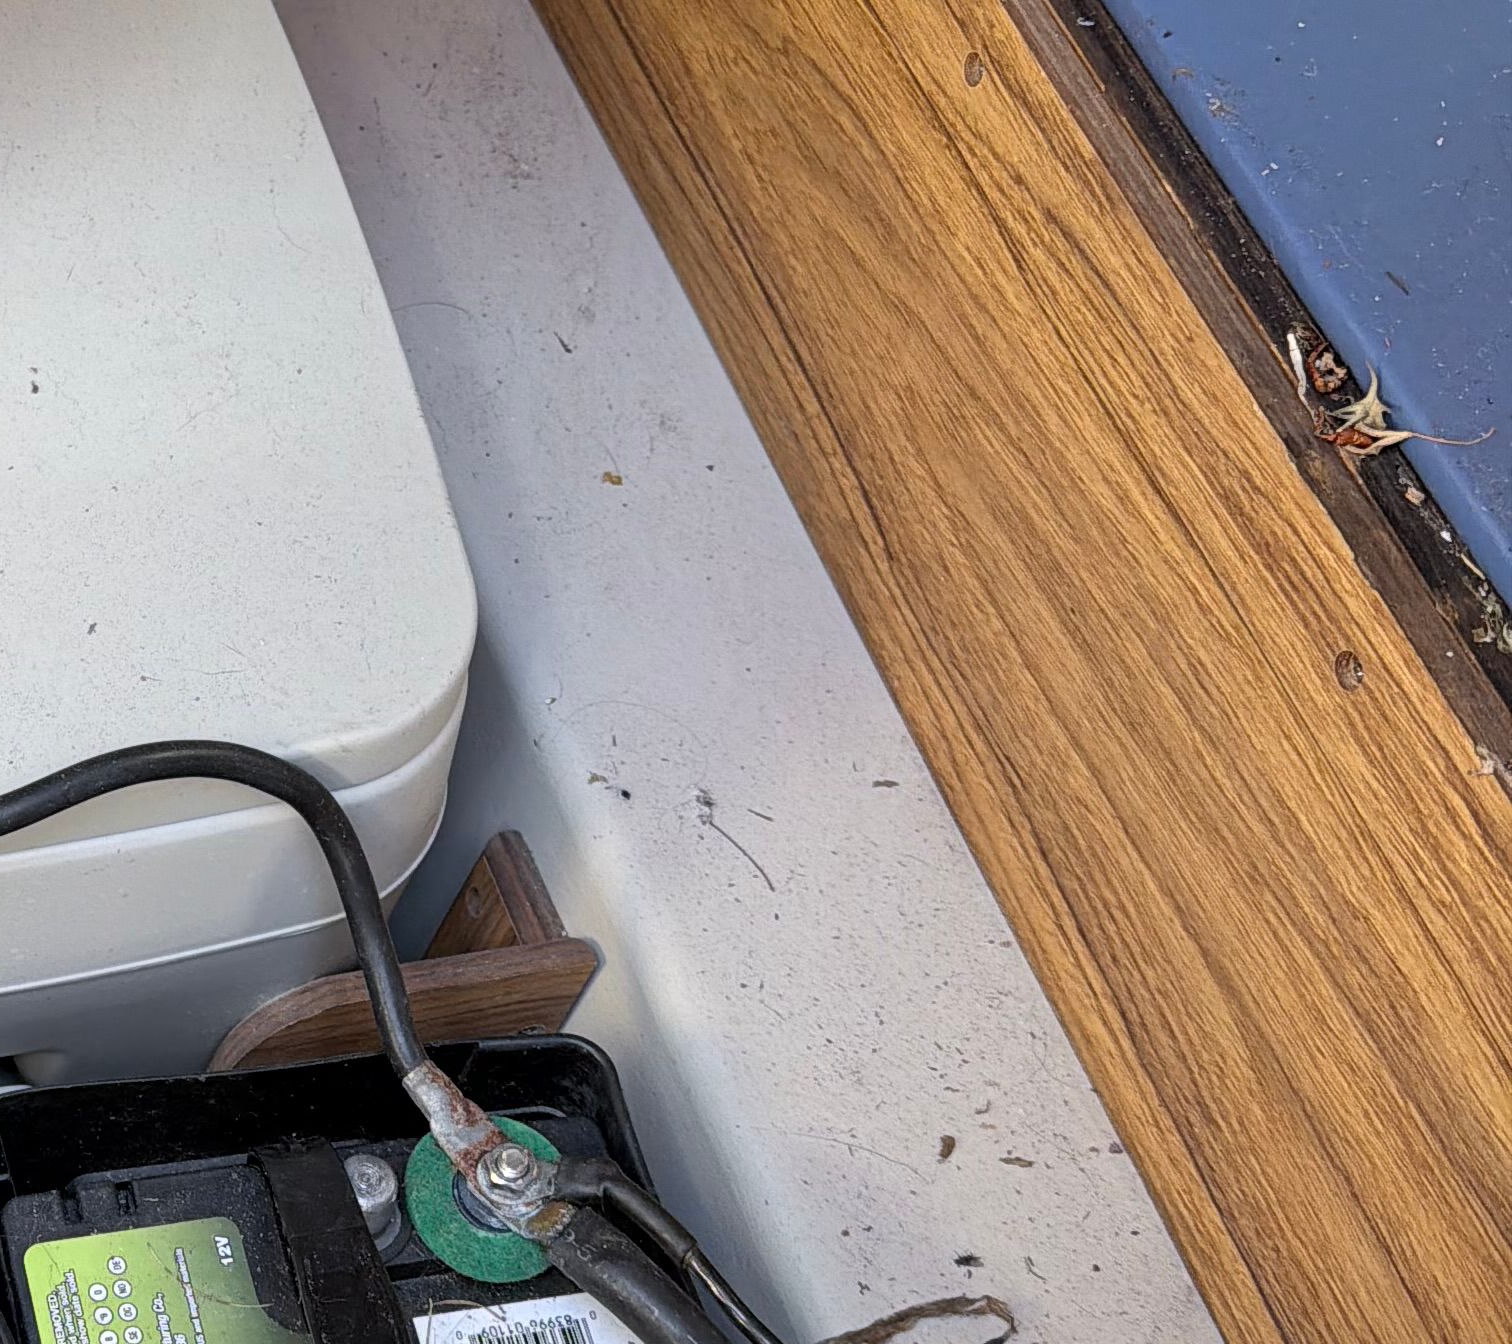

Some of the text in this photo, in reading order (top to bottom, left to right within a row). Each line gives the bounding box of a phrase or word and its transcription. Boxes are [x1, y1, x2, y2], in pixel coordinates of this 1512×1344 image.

[214, 1234, 235, 1267] 12V
[70, 1294, 83, 1316] date
[61, 1307, 75, 1334] when
[75, 1318, 89, 1344] show
